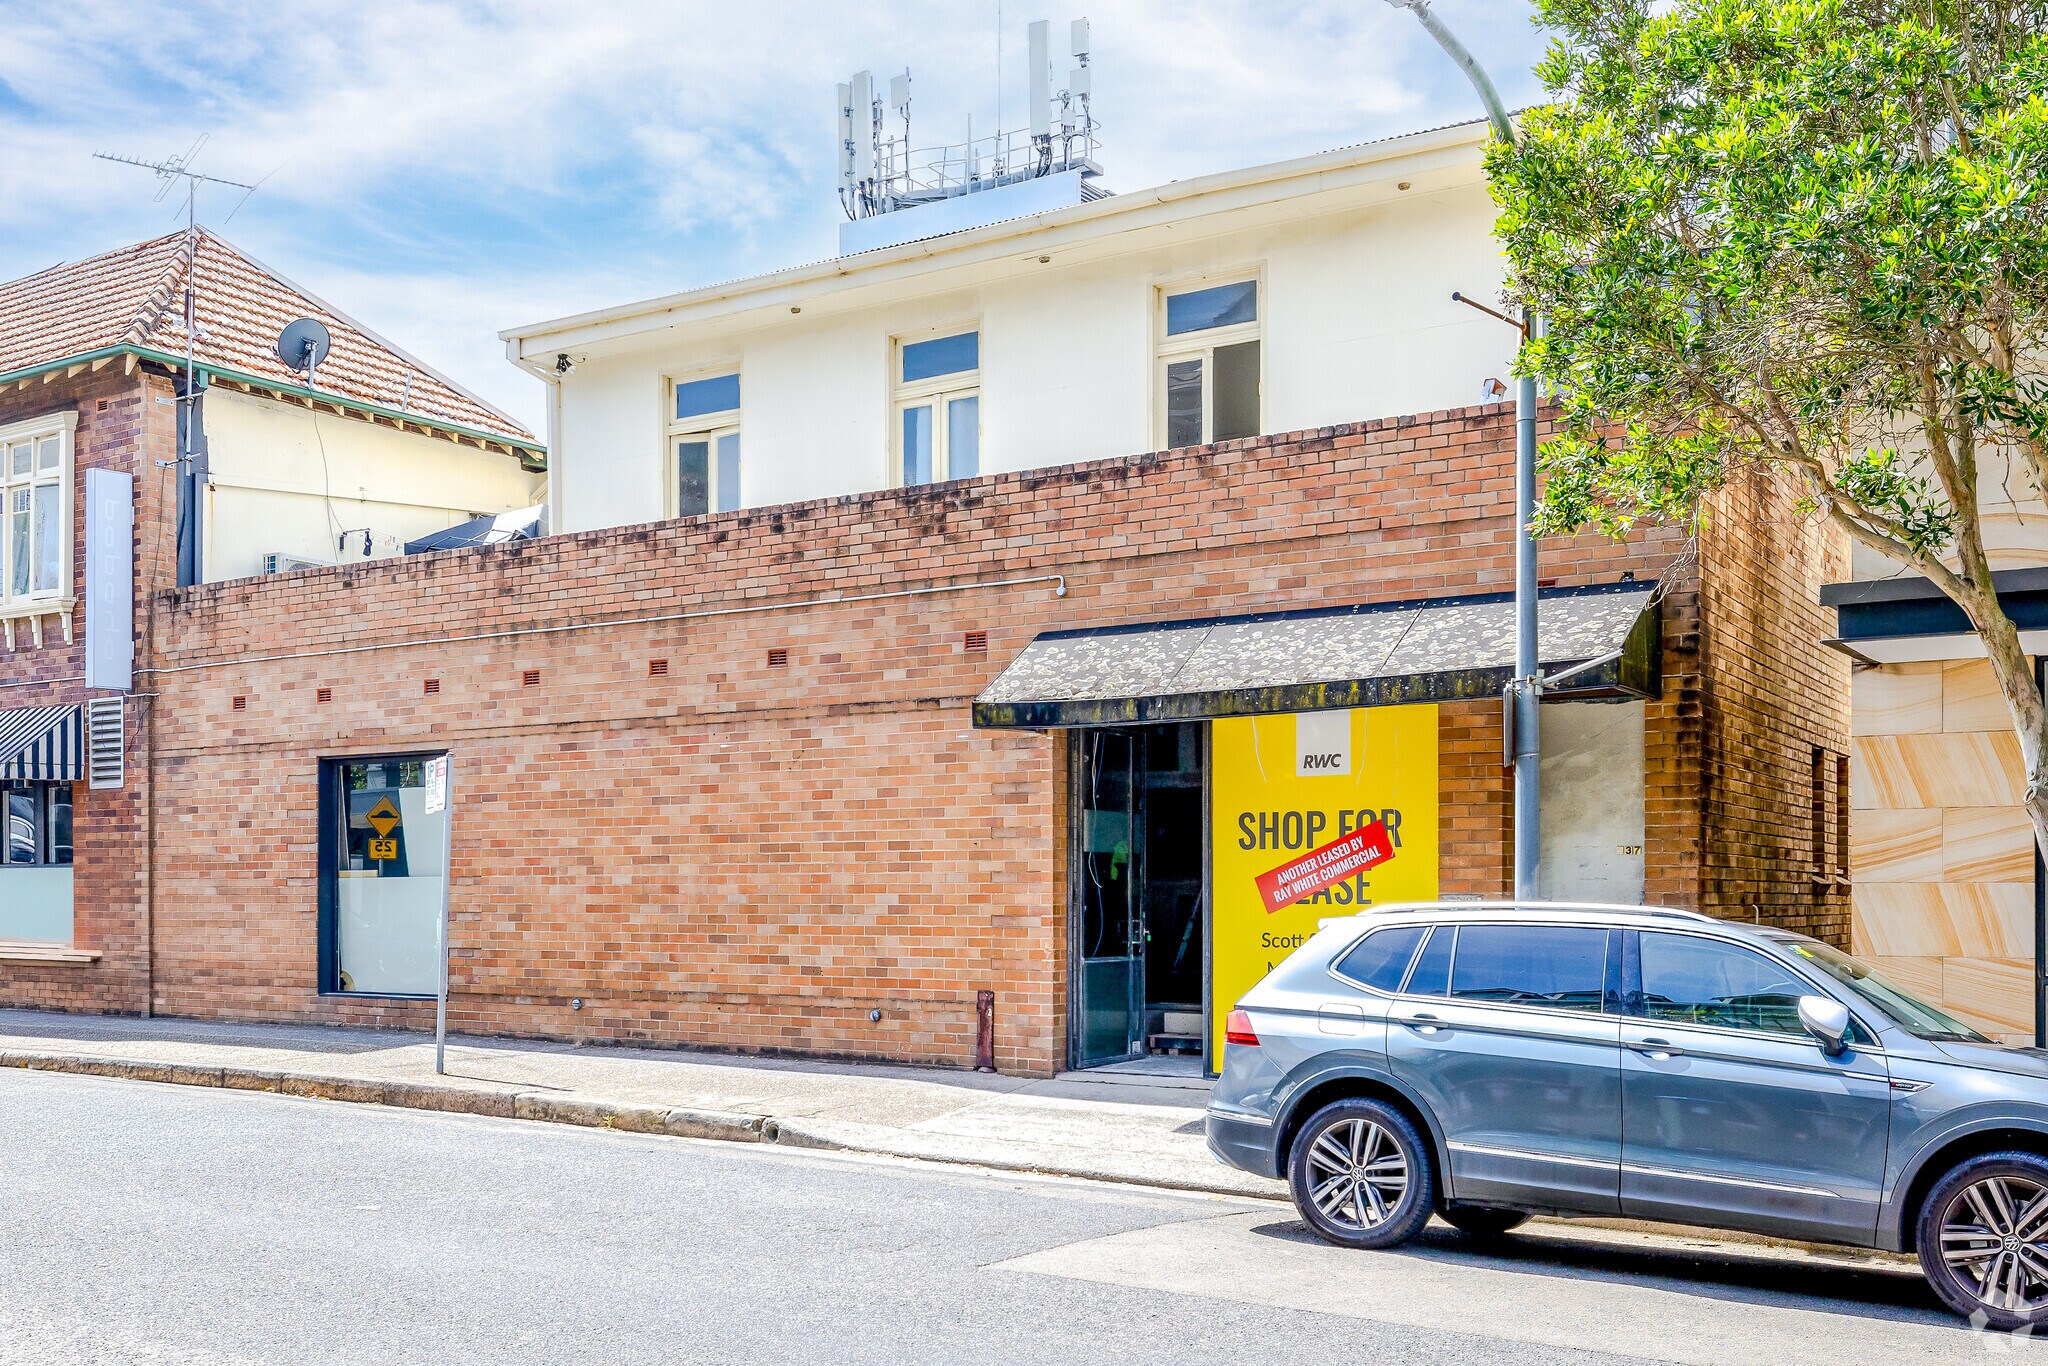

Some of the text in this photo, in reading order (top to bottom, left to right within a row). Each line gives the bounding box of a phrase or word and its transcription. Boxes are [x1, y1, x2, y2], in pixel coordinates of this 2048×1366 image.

[1303, 753, 1342, 769] RWC
[1238, 811, 1327, 850] SHOP
[1277, 835, 1364, 886] ANOTHER LEASED BY
[1625, 846, 1642, 855] 37
[1273, 845, 1382, 903] RAY WHITE COMMERCIAL
[1261, 932, 1304, 949] Scott
